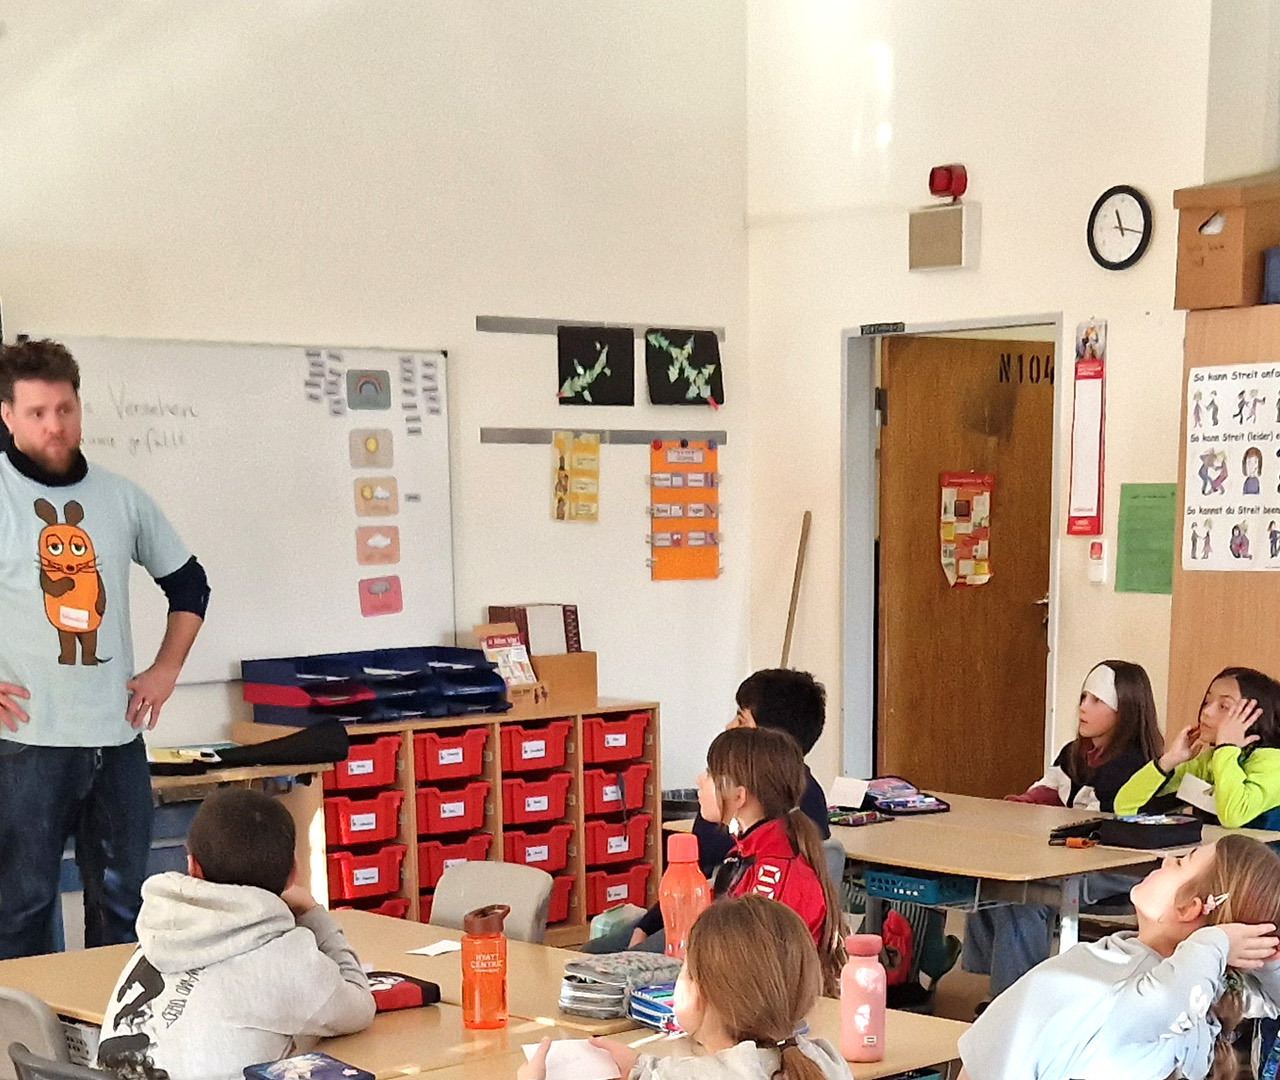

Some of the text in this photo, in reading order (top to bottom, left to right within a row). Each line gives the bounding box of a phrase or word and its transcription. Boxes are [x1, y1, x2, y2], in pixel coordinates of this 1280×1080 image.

[999, 353, 1055, 385] N104
[1193, 373, 1205, 382] So
[1208, 372, 1228, 381] kann
[1231, 370, 1258, 380] Streit
[1190, 434, 1200, 443] So
[1203, 433, 1220, 442] kann
[1223, 432, 1245, 442] Streit
[1247, 431, 1274, 442] (leider)
[1187, 507, 1196, 515] So
[1199, 506, 1223, 515] kannst
[1226, 507, 1235, 515] du
[1238, 506, 1261, 515] Streit
